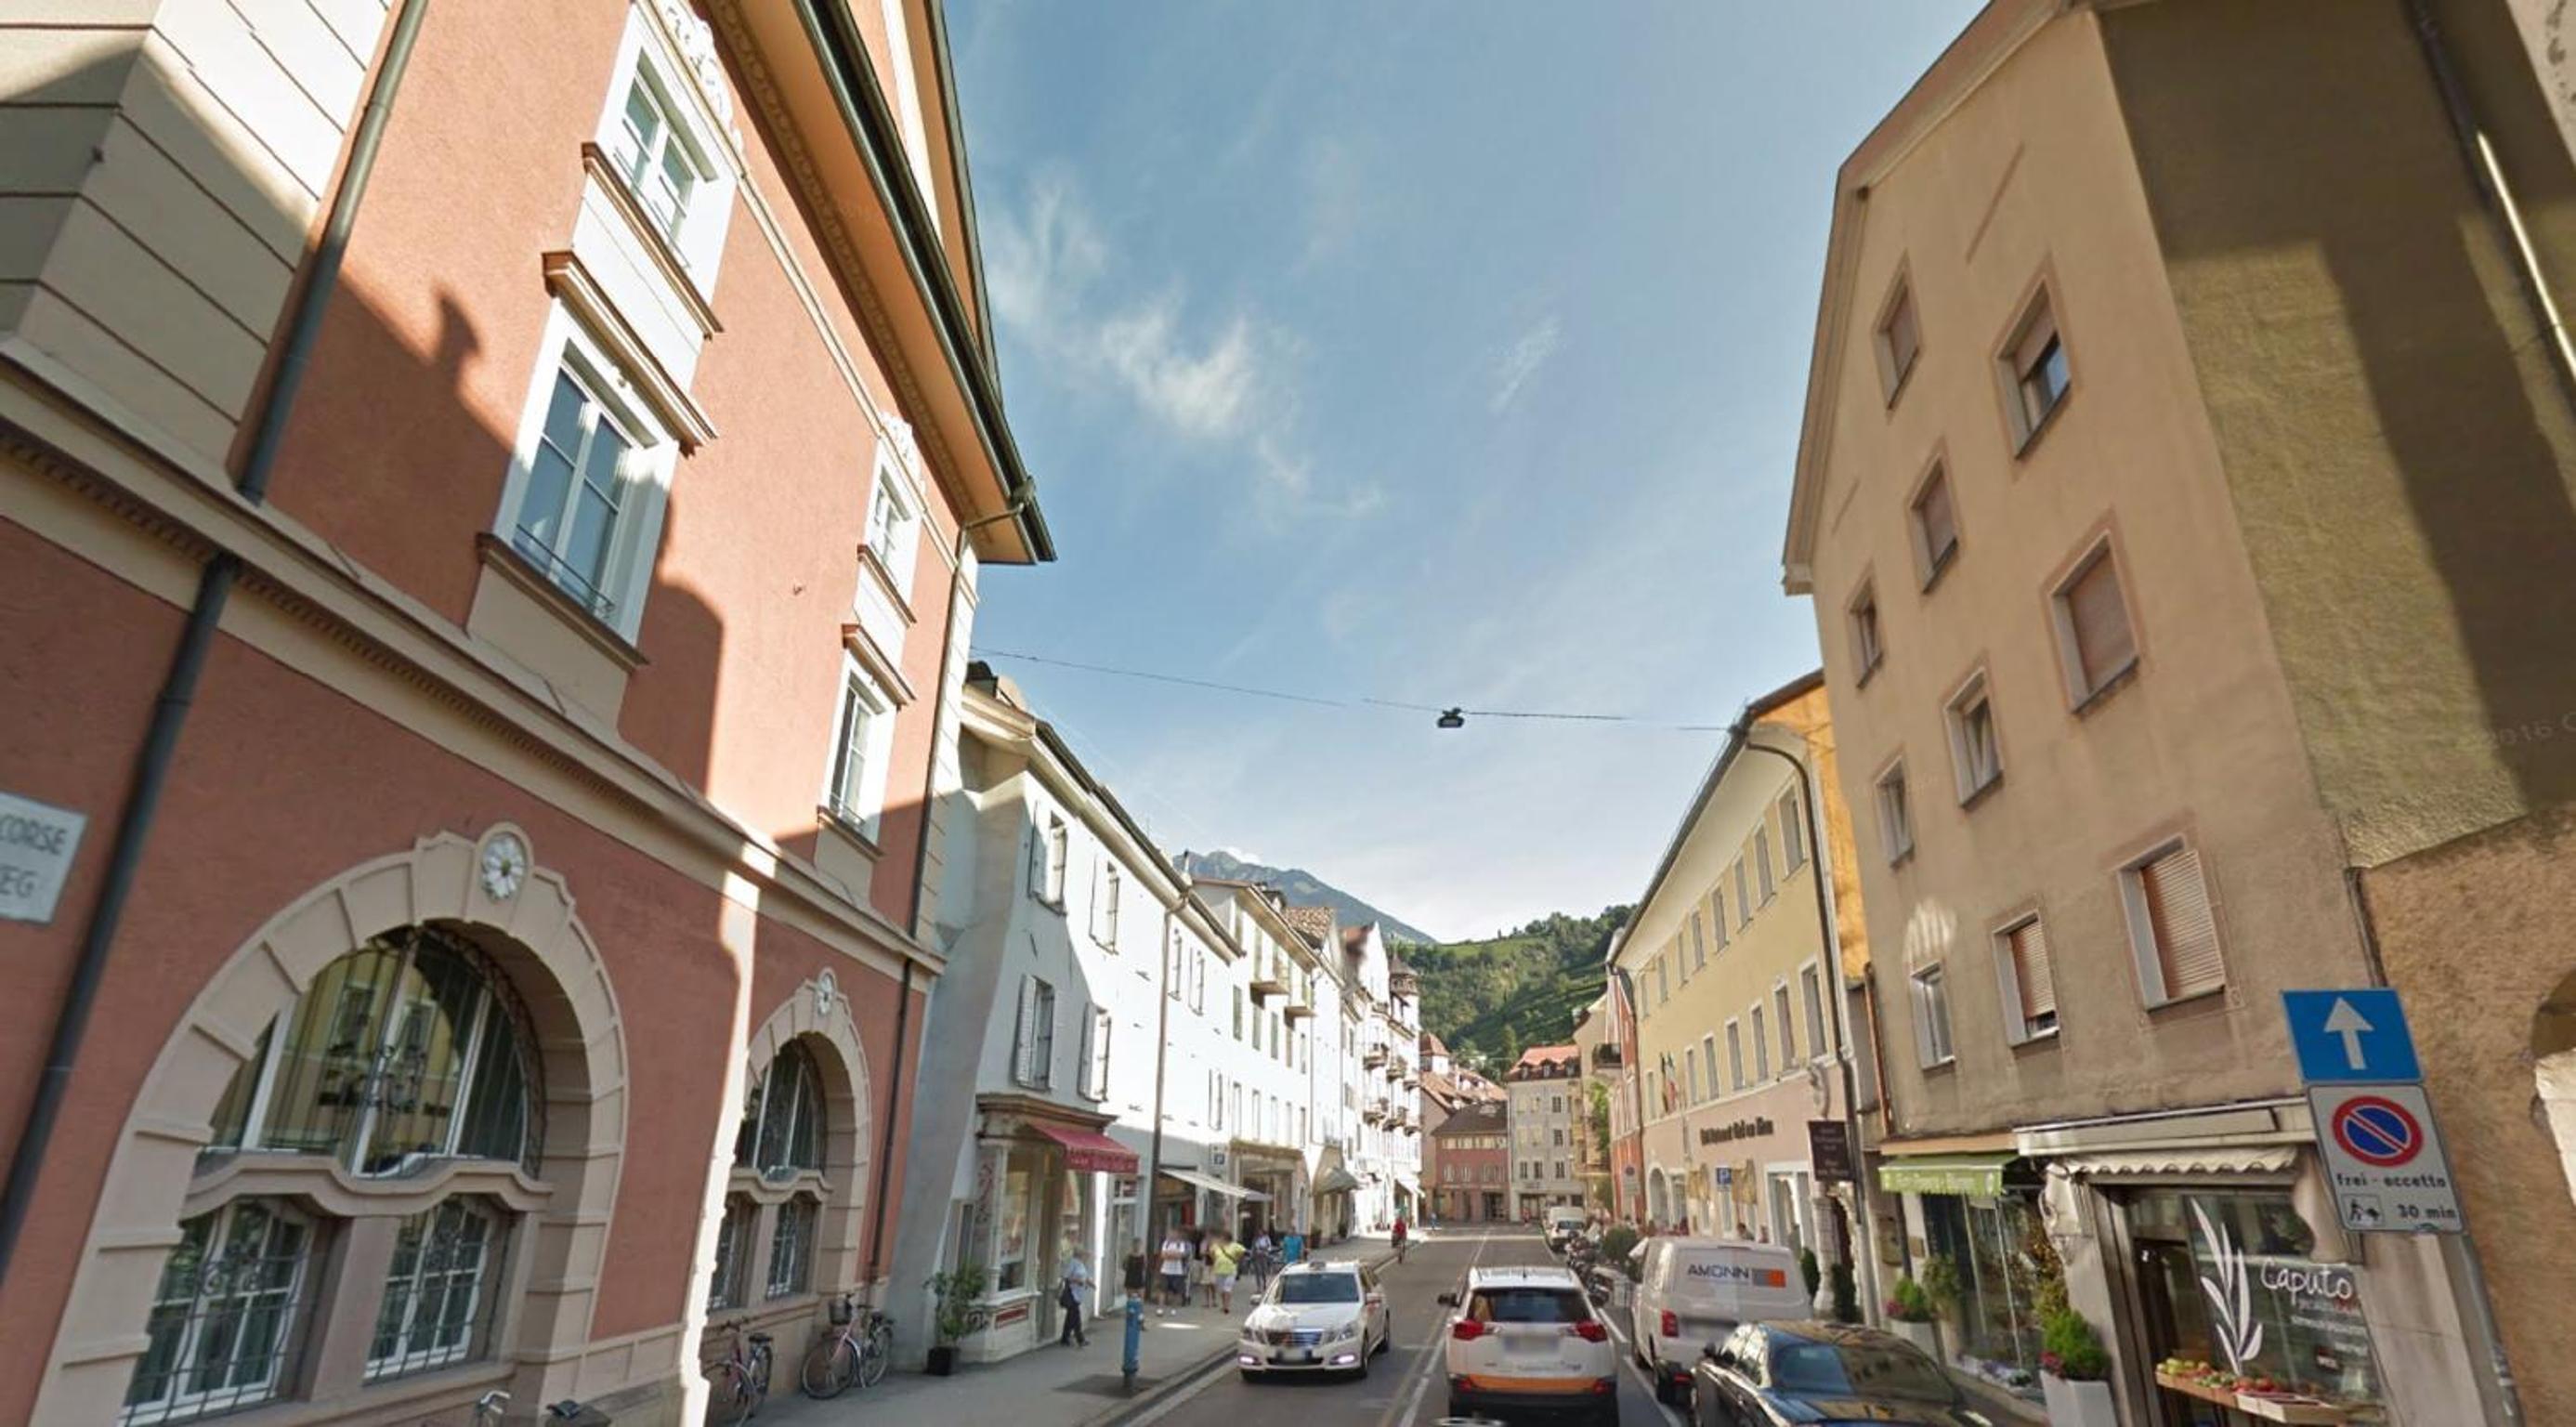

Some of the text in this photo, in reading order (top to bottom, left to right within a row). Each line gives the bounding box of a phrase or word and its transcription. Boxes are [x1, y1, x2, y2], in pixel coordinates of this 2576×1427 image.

[2336, 1172, 2368, 1186] frei
[2384, 1174, 2447, 1188] eccetto
[2398, 1204, 2455, 1219] 30 min
[1687, 1263, 1749, 1279] AMONN
[2260, 1256, 2352, 1306] Caputo
